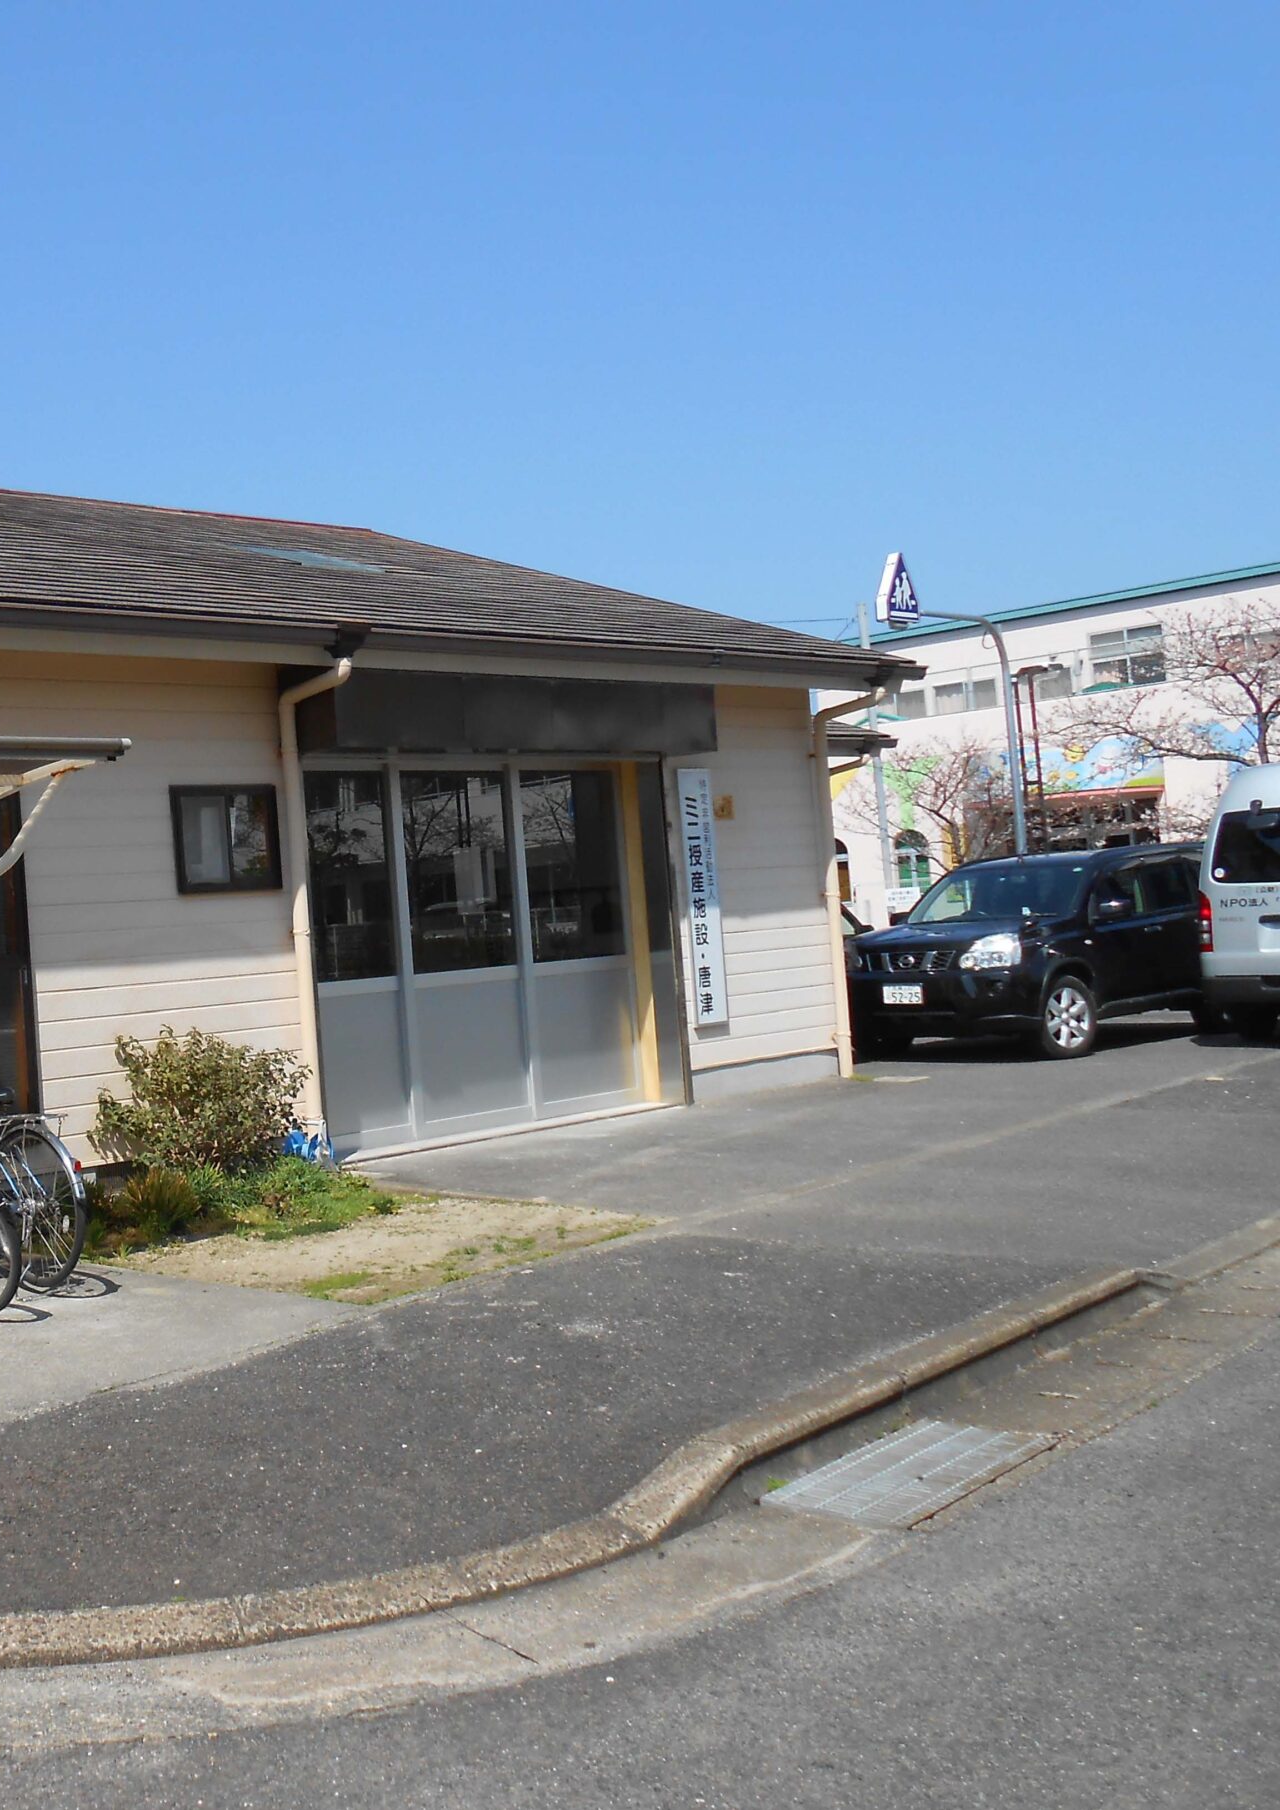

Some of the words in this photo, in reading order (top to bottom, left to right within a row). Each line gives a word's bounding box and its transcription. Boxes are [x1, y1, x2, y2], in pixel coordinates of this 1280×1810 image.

[684, 796, 715, 1017] ミニ授産施設・唐津
[891, 992, 921, 1003] 52-25
